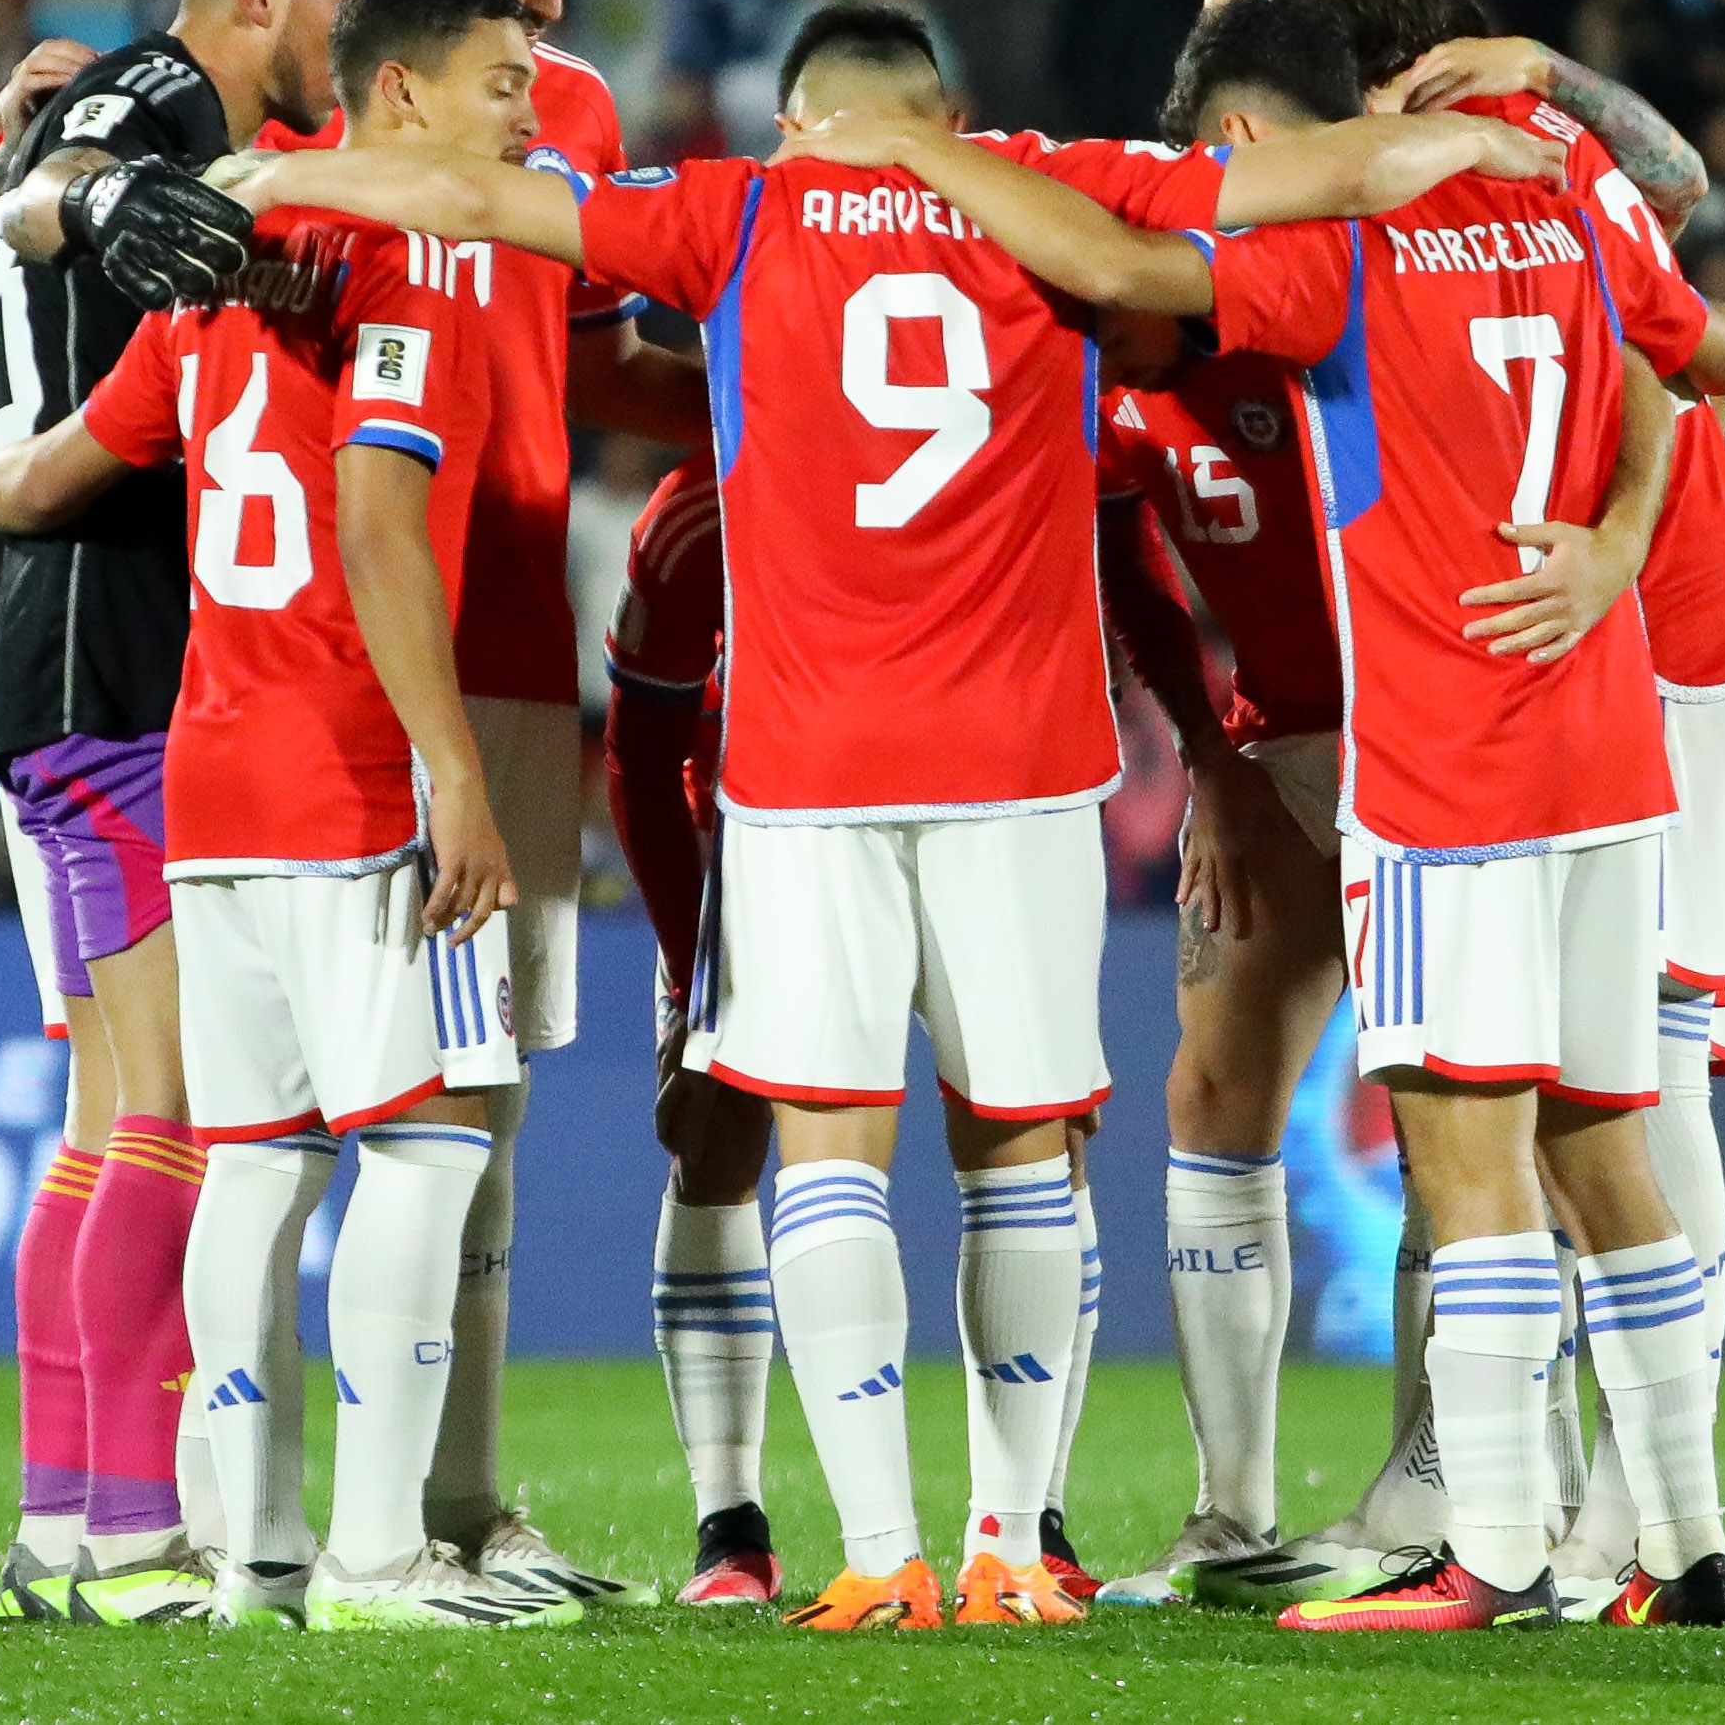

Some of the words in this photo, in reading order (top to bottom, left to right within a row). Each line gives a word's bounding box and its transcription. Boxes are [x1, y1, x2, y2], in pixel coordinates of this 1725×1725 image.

[842, 272, 992, 529] 9
[1469, 313, 1568, 574] 7
[1164, 444, 1261, 545] 15
[1345, 879, 1371, 988] 7
[1166, 1241, 1264, 1274] HILE
